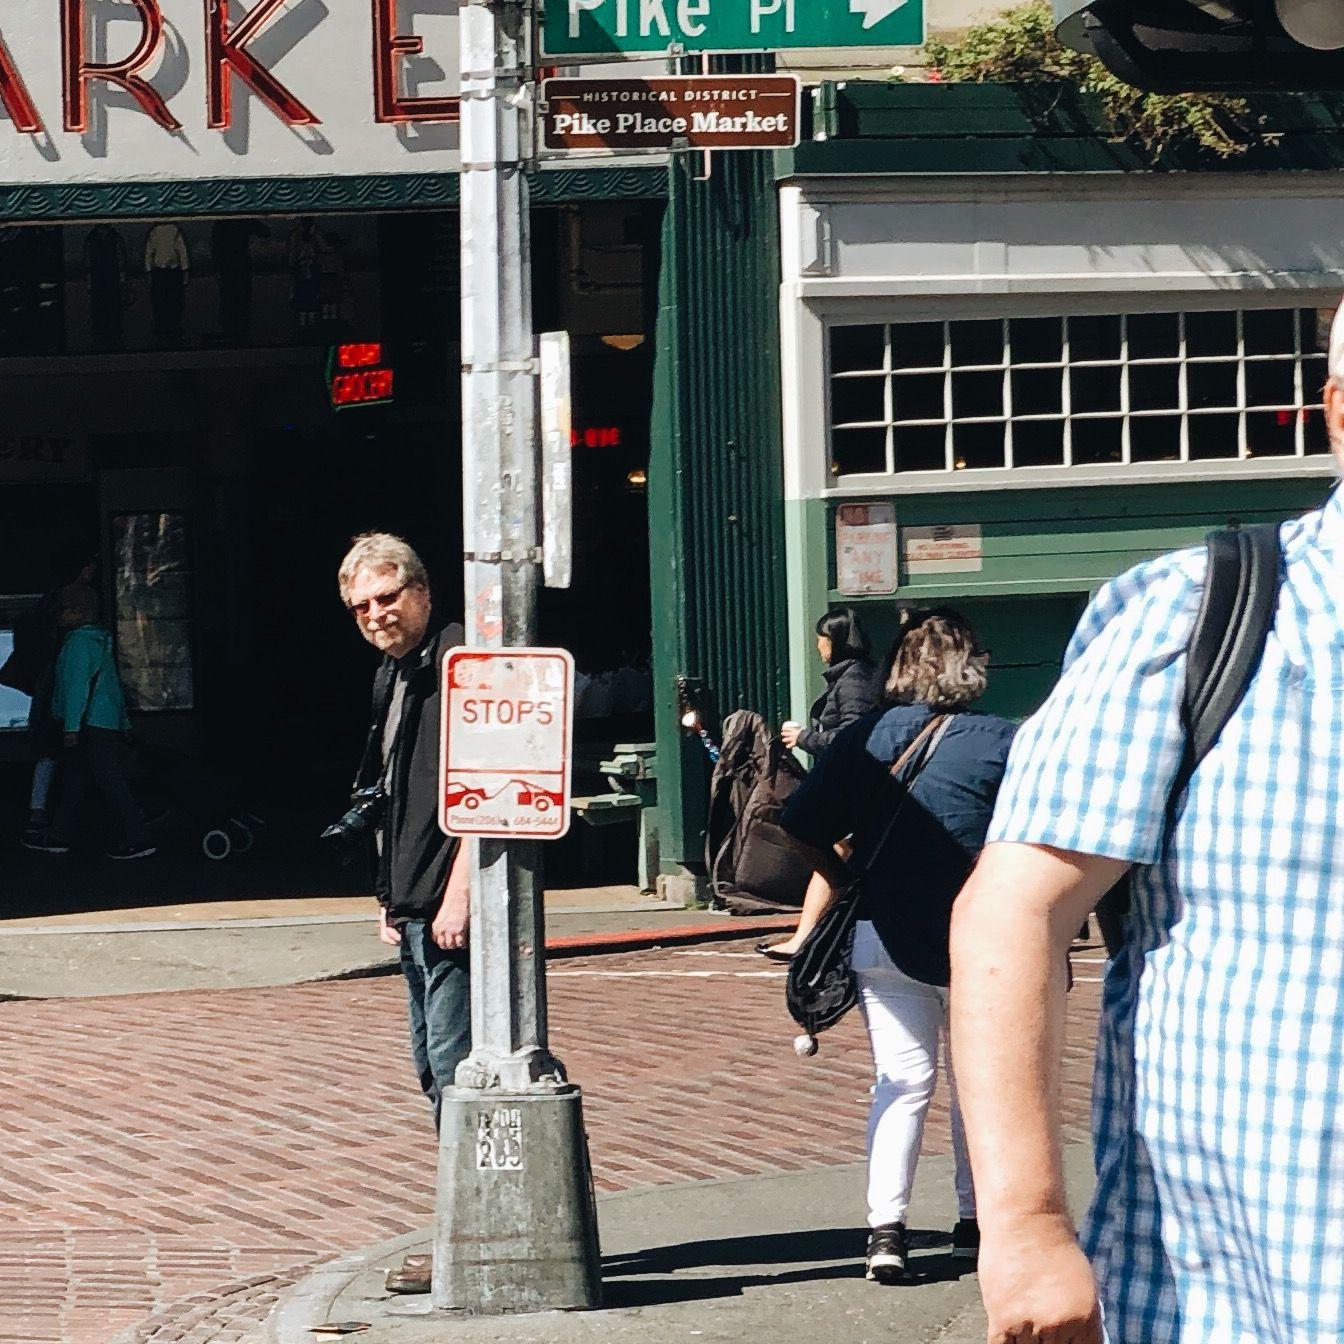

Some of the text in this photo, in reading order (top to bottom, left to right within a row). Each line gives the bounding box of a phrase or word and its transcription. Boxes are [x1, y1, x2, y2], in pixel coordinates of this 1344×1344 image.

[582, 89, 758, 103] HISTORICAL DISTRICT
[552, 110, 788, 135] Pike Place Market
[462, 699, 553, 726] STOPS
